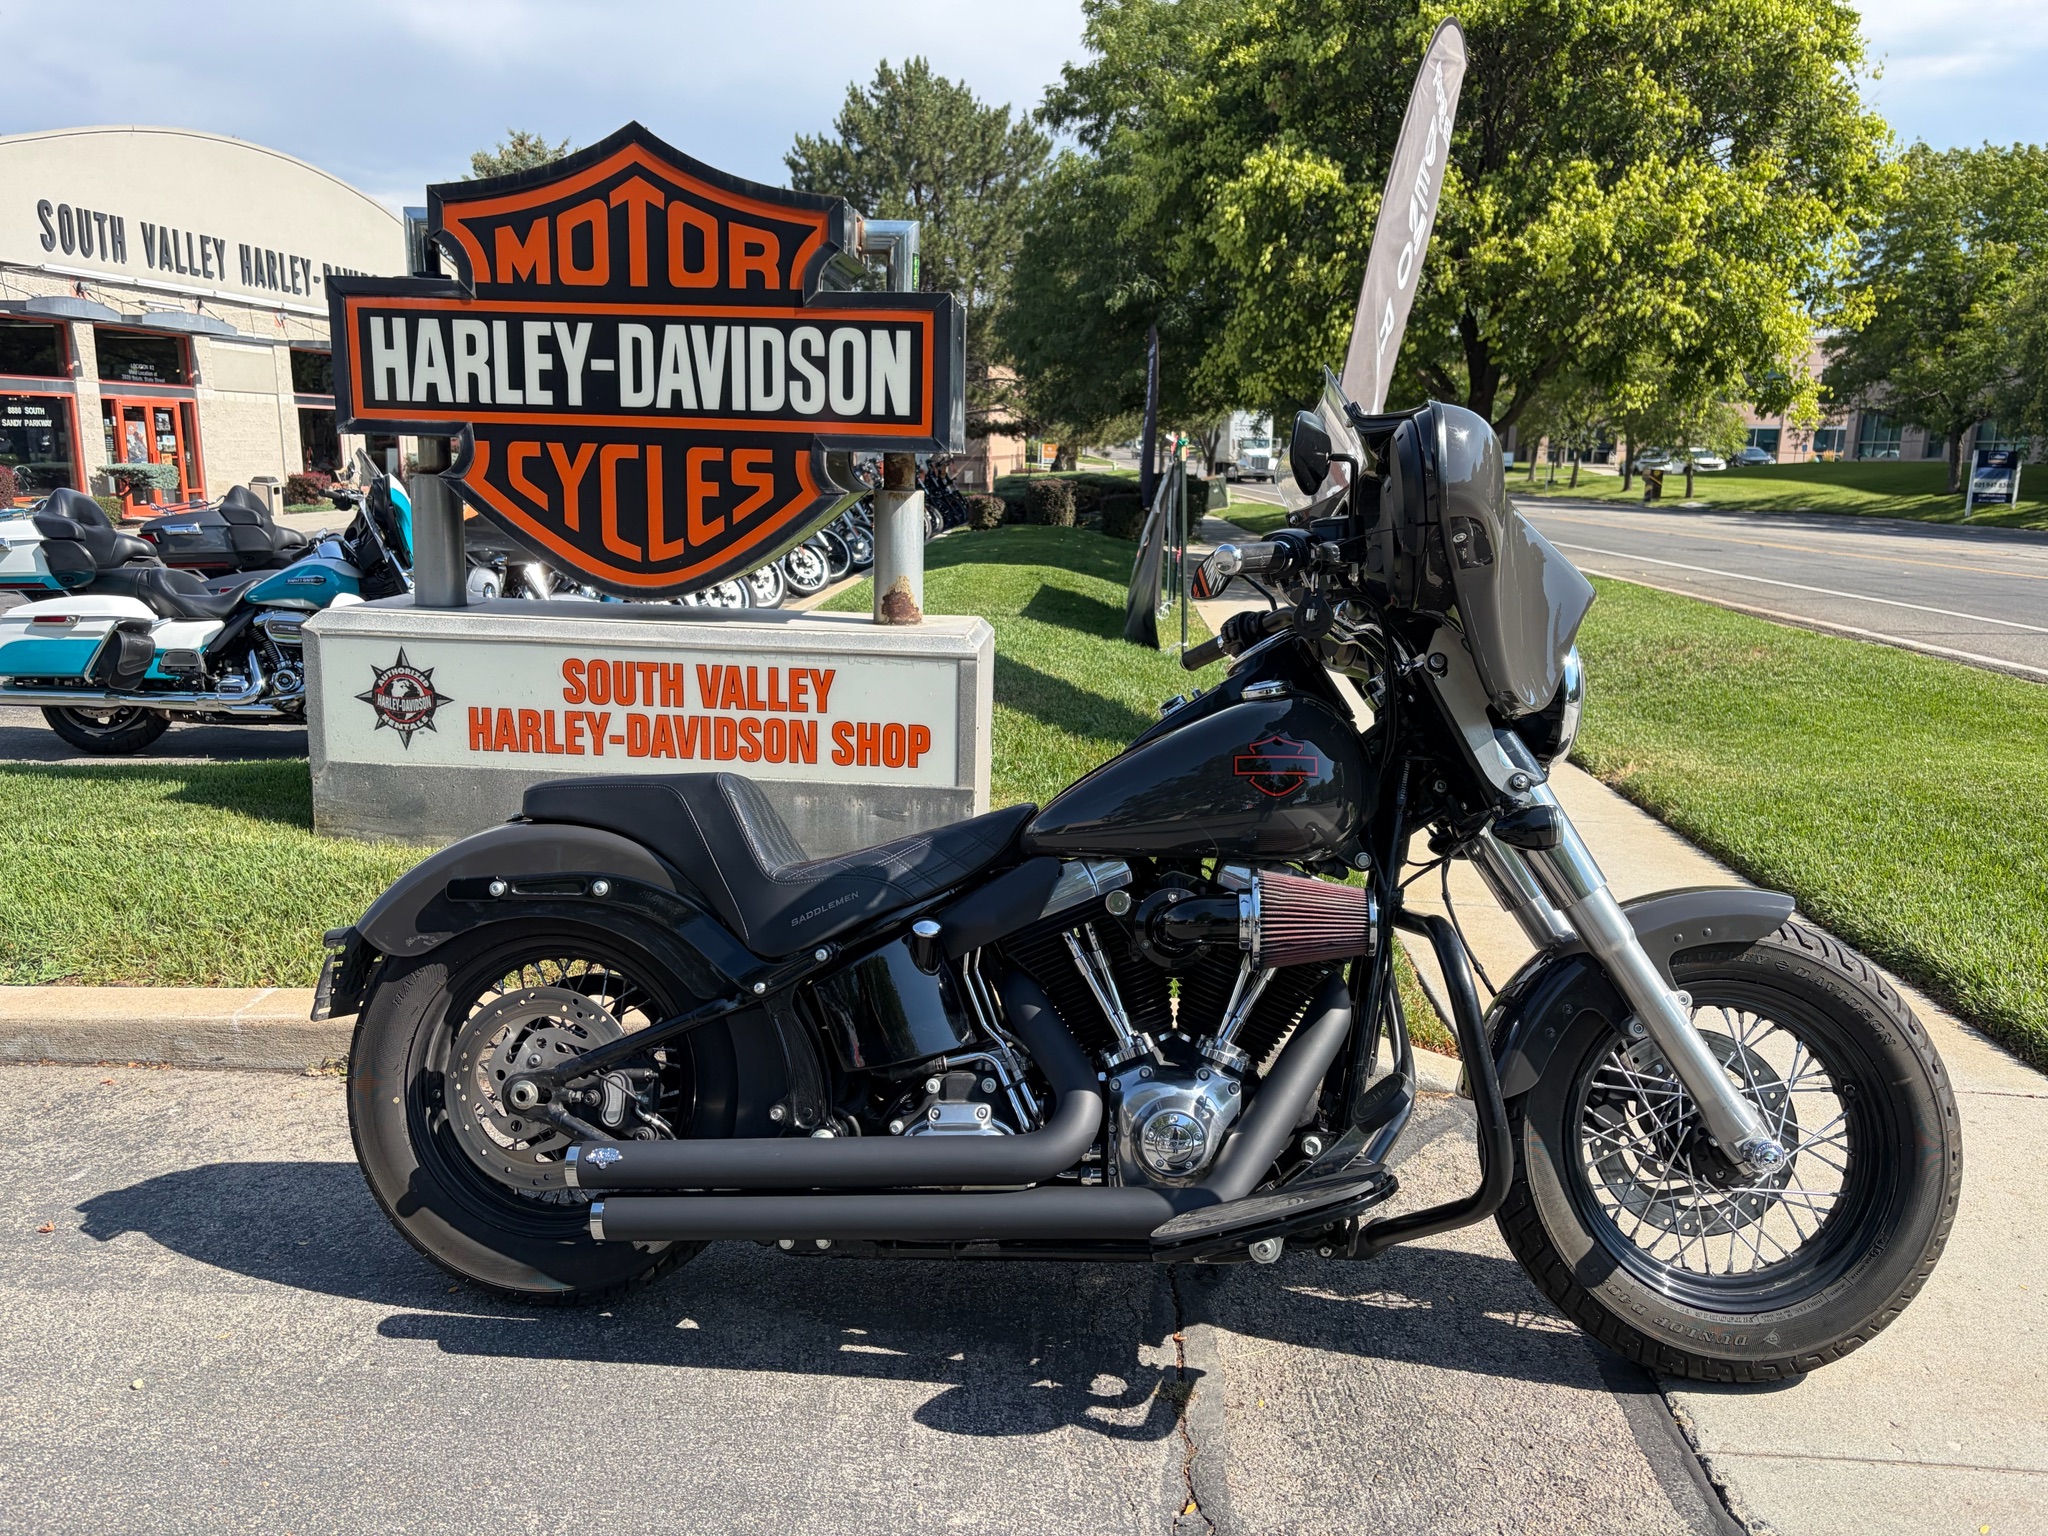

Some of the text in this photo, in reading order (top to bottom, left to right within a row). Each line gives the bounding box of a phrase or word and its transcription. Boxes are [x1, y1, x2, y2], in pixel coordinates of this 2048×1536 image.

[37, 198, 379, 297] SOUTH VALLEY HARLEY-
[494, 174, 782, 291] MOTOR
[369, 315, 912, 418] HARLEY-DAVIDSON
[1, 418, 53, 427] SANDY PARKWAY
[24, 406, 45, 415] SOUTH
[506, 440, 775, 564] CYCLES
[377, 667, 430, 688] AUTHORIZED
[562, 657, 837, 714] SOUTH VALLEY
[377, 693, 432, 712] HARLEY-DAVIDSON
[381, 713, 430, 731] RENTALS
[467, 705, 932, 769] HARLEY-DAVIDSON SHOP
[791, 890, 860, 927] SADDLEMEN
[1792, 966, 1898, 1046] DAVIDSON
[1652, 1316, 1749, 1347] DUNLOP
